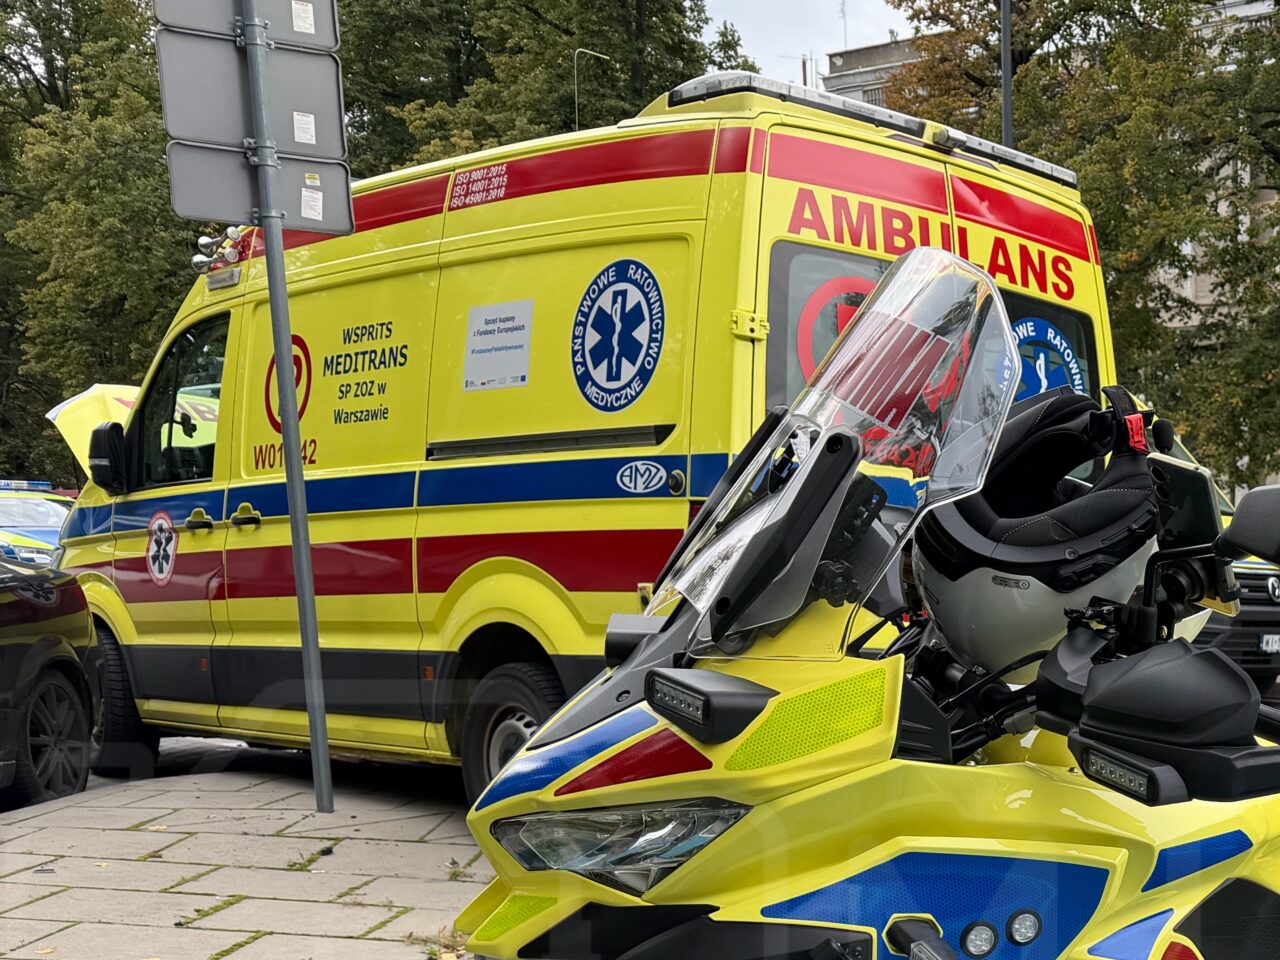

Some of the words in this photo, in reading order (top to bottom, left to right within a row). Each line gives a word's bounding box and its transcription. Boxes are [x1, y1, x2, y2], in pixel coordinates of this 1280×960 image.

[453, 184, 467, 197] ISO
[468, 175, 508, 193] 14001:2015
[455, 172, 469, 185] ISO
[470, 163, 507, 181] 9001:2015
[450, 195, 465, 208] ISO
[787, 186, 1076, 302] AMBULANS
[571, 266, 617, 376] PAŃSTWOWE
[627, 263, 663, 370] RATOWNICTWO
[343, 321, 393, 345] WSPRiTS
[322, 344, 408, 377] MEDITRANS
[338, 384, 351, 400] SP
[353, 380, 375, 398] ZOZ
[584, 375, 644, 408] MEDYCZNE
[333, 403, 389, 425] Warszawie
